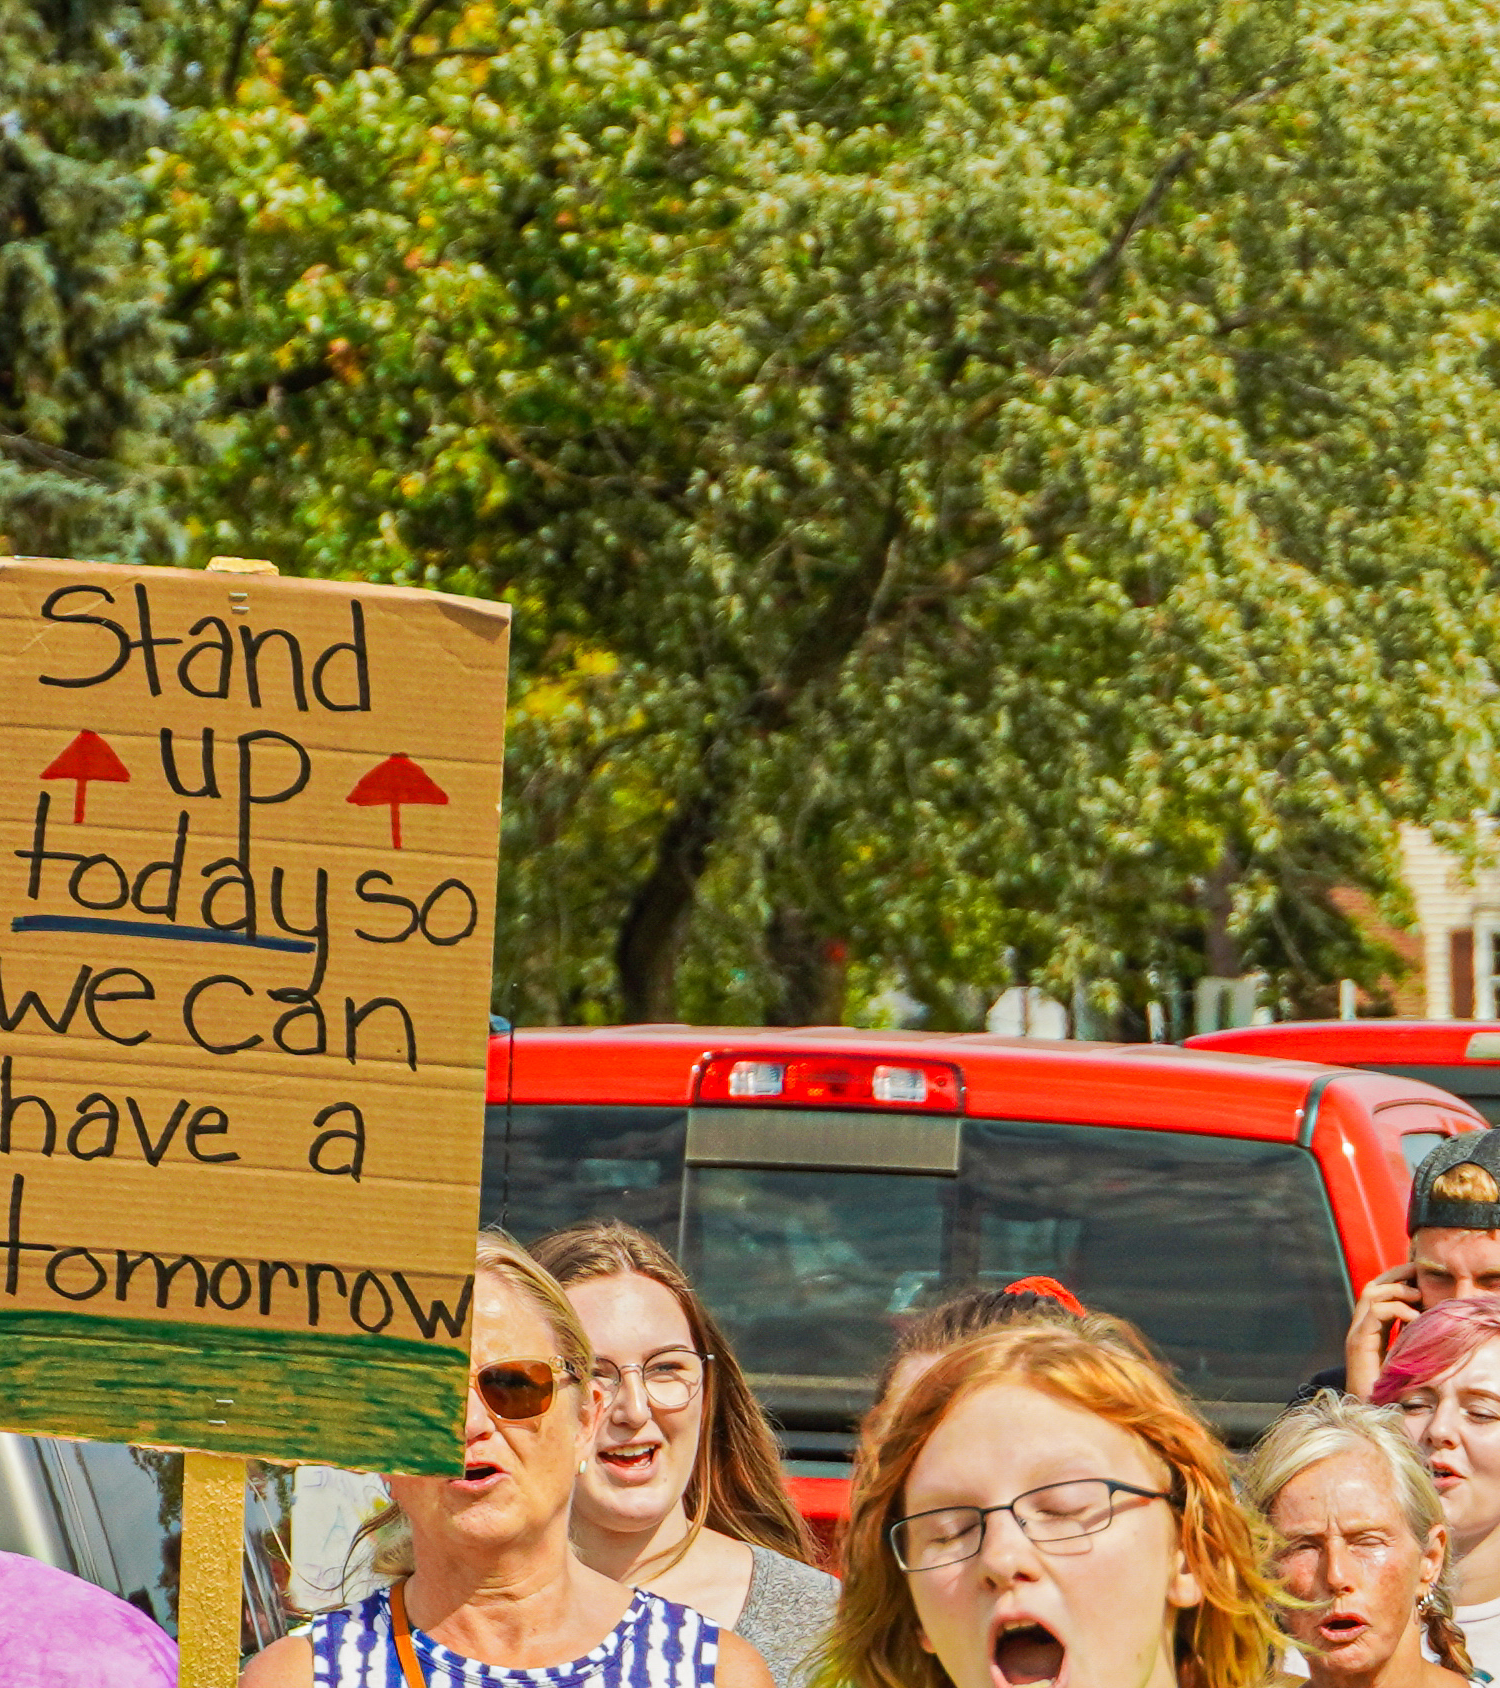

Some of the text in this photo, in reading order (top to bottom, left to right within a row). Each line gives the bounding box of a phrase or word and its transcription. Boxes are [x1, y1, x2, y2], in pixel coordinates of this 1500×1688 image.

[38, 583, 371, 713] Stand
[159, 726, 311, 868] up
[14, 791, 478, 994] today so
[182, 975, 418, 1072] can
[0, 1055, 366, 1182] have a
